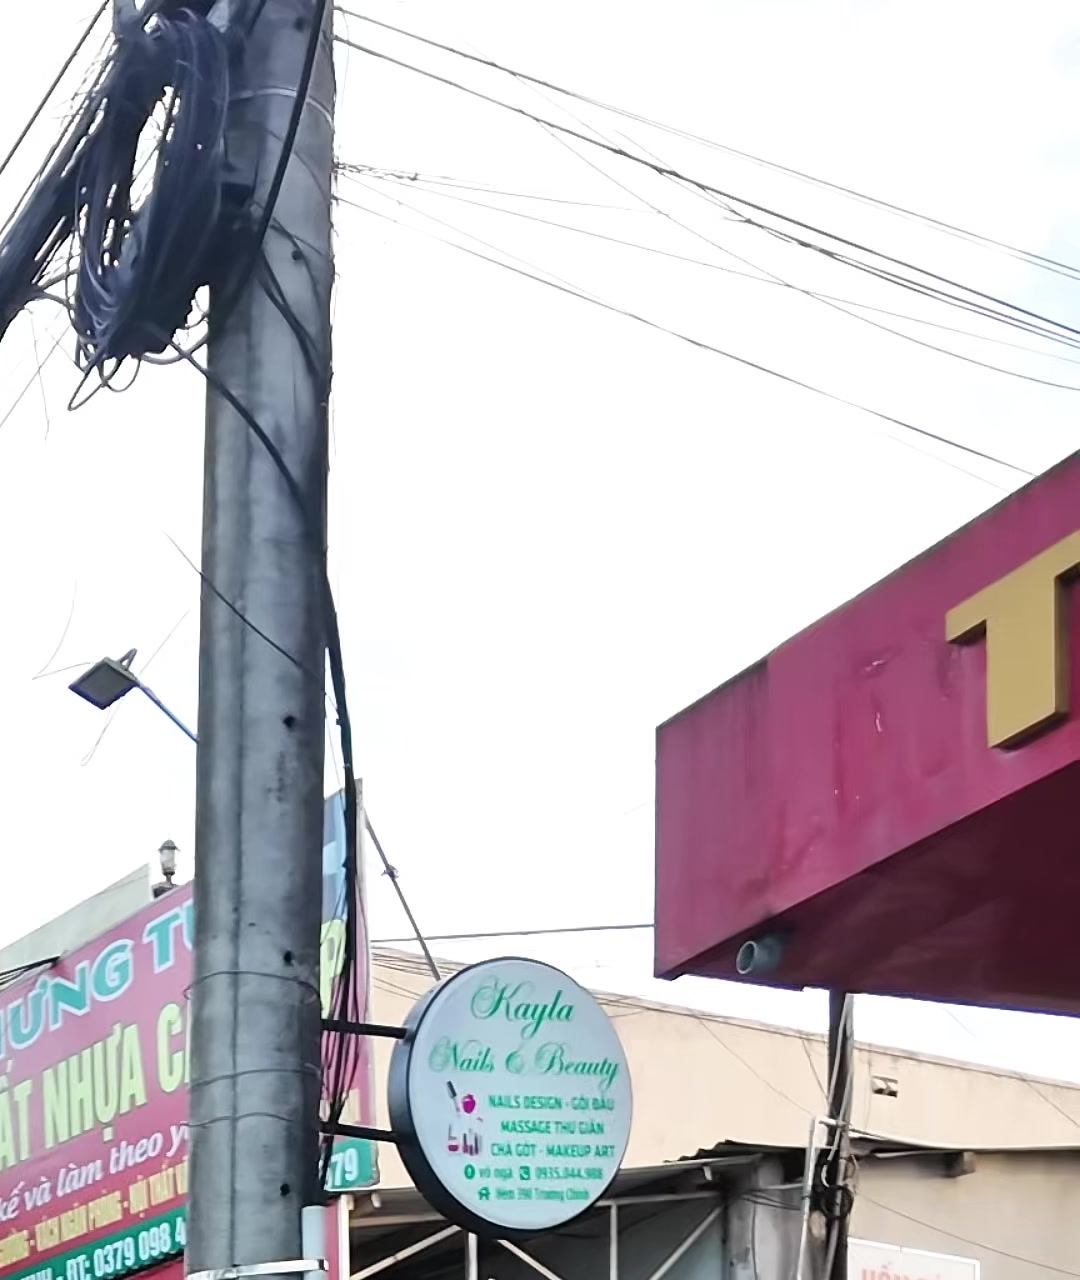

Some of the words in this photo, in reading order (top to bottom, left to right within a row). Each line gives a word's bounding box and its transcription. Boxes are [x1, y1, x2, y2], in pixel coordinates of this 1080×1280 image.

[470, 975, 575, 1040] Kayla
[42, 1022, 147, 1149] NHỰA
[427, 1036, 495, 1073] Nails
[534, 1042, 619, 1091] Beauty
[501, 1120, 551, 1134] MASSAGE
[546, 1144, 591, 1158] MAKEUP
[594, 1144, 615, 1158] ART
[24, 1176, 51, 1211] và
[56, 1163, 104, 1197] làm
[109, 1131, 164, 1174] theo
[94, 1237, 135, 1278] 0379
[138, 1222, 170, 1259] 098
